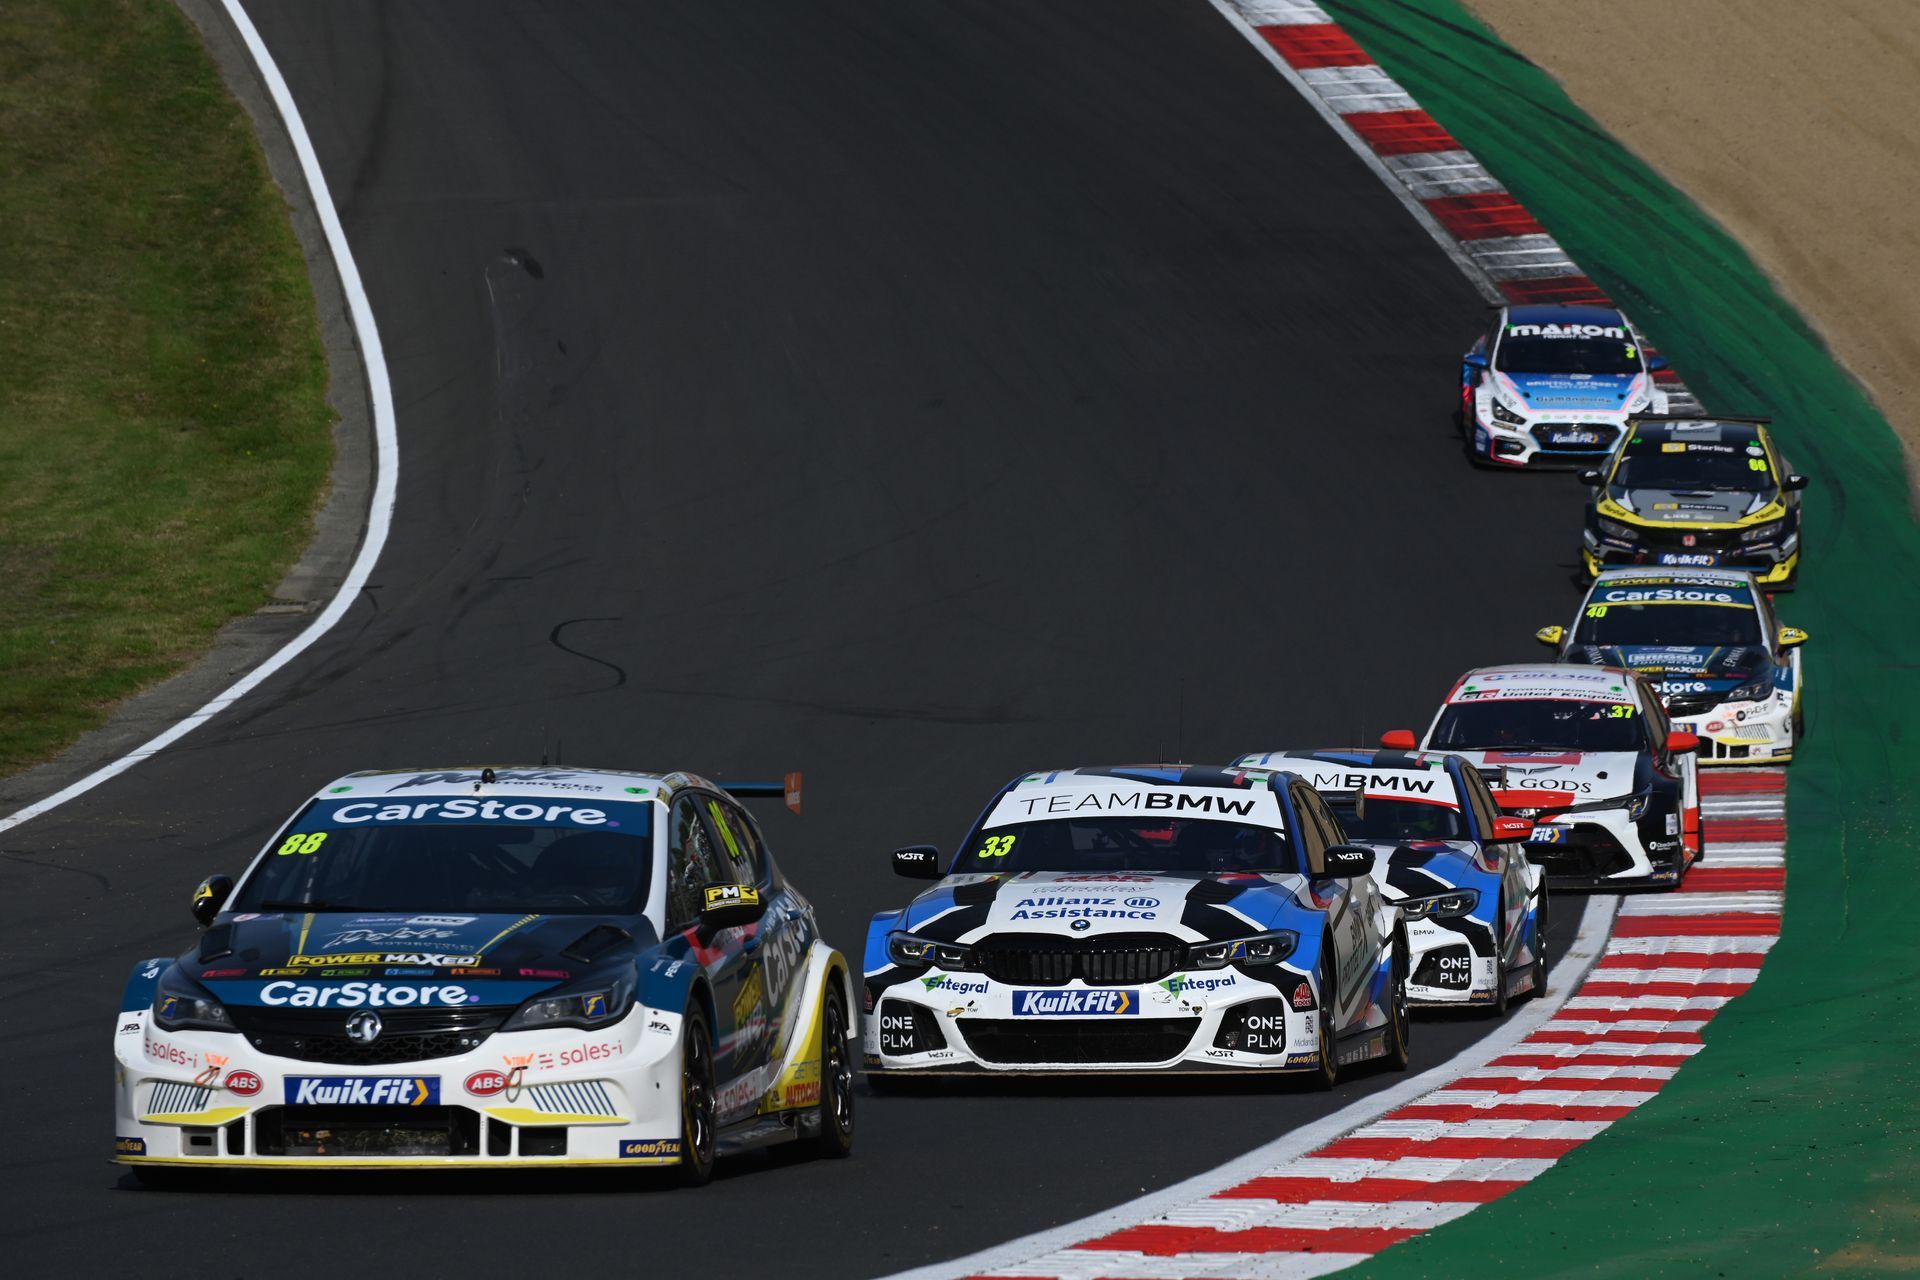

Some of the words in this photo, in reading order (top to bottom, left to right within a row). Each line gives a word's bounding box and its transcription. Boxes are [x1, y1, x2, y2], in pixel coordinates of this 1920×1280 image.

[1609, 577, 1670, 588] POWER
[1673, 576, 1737, 588] MAXED
[1586, 606, 1608, 618] 40
[1561, 692, 1627, 702] Kingdom
[1611, 705, 1634, 719] 37
[1520, 779, 1592, 793] GODS
[278, 832, 328, 856] 88
[978, 835, 1016, 858] 33
[1015, 896, 1116, 907] Allianz
[1010, 907, 1157, 921] Assistance
[293, 954, 380, 965] POWER
[385, 953, 476, 967] MAXED
[1440, 957, 1470, 969] ONE
[1168, 974, 1236, 993] Entegral
[1440, 972, 1469, 983] PLM
[926, 976, 989, 995] Entegral
[881, 1016, 913, 1030] ONE
[1247, 1016, 1283, 1030] ONE
[882, 1034, 913, 1048] PLM
[1247, 1034, 1282, 1048] PLM
[152, 1042, 198, 1068] sales-i
[560, 1040, 623, 1067] sales-i
[229, 1076, 257, 1089] ABS
[471, 1076, 505, 1090] ABS
